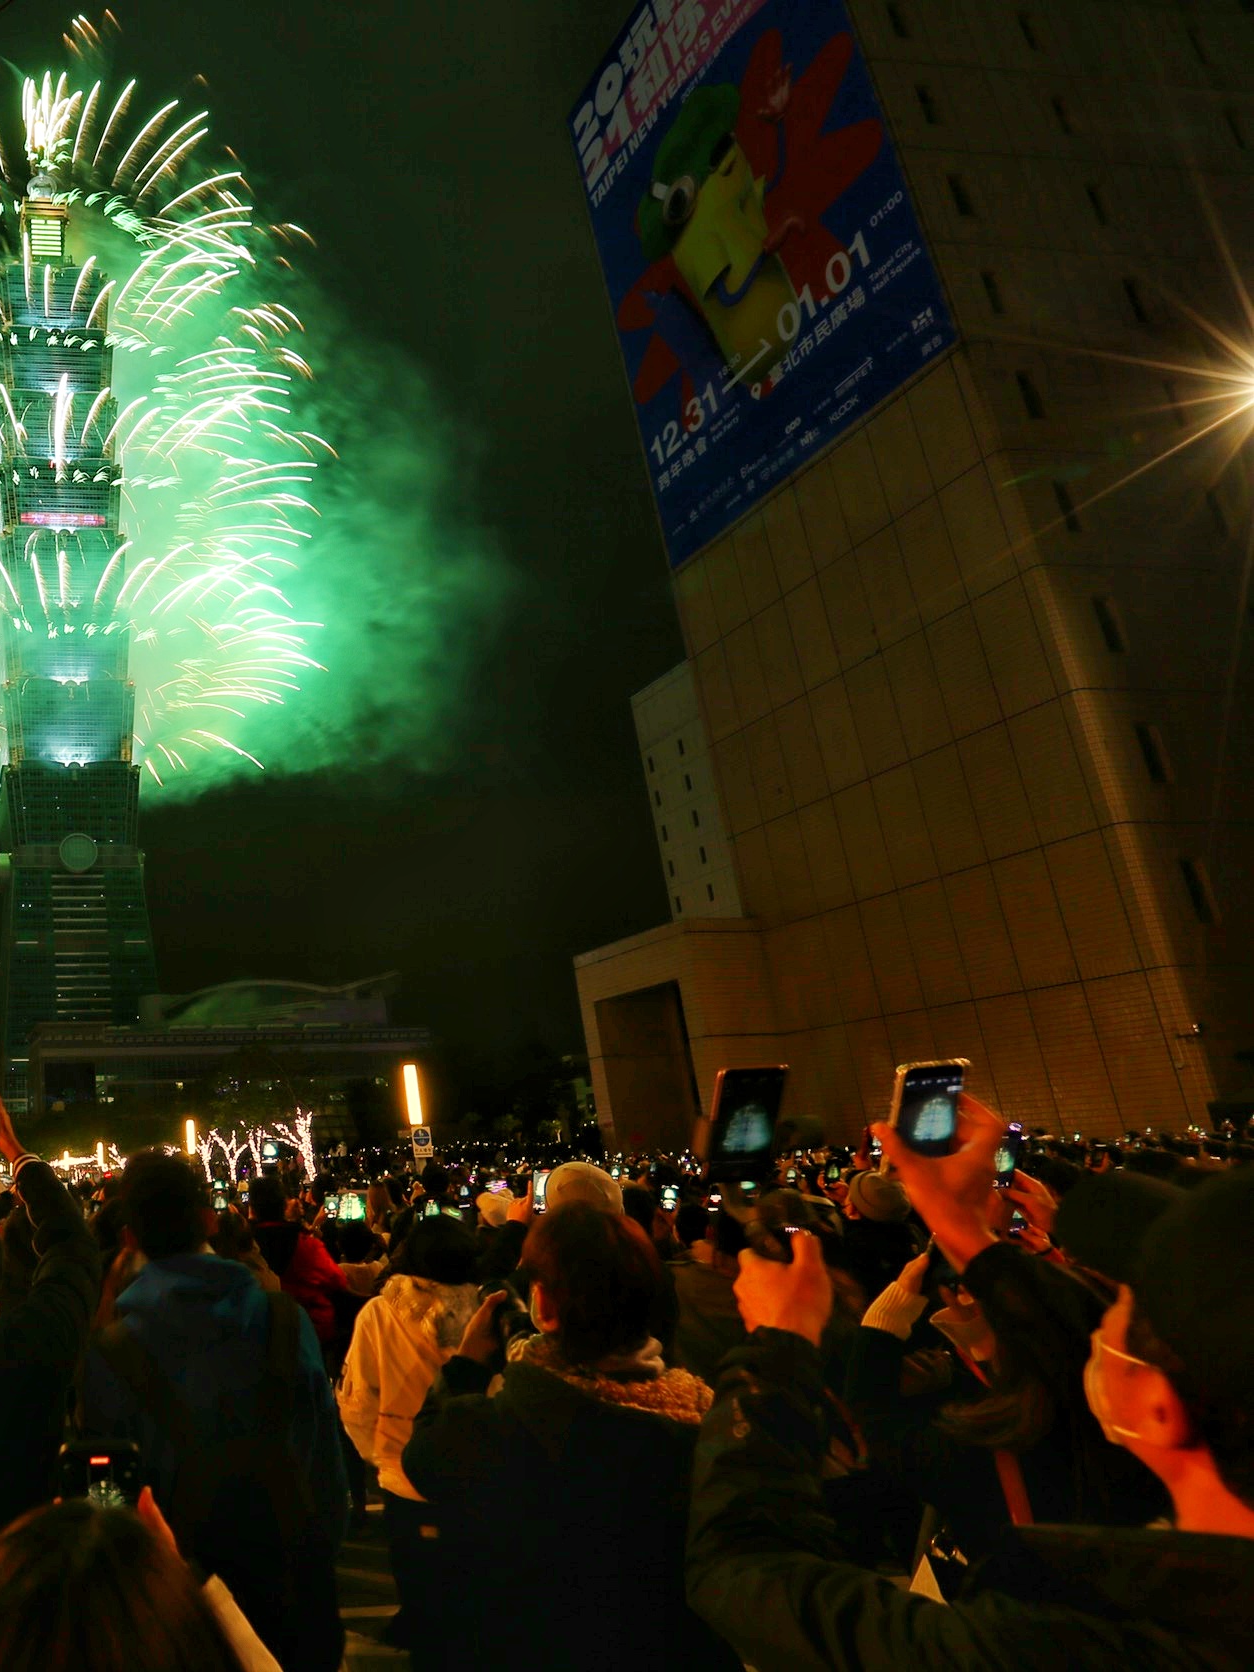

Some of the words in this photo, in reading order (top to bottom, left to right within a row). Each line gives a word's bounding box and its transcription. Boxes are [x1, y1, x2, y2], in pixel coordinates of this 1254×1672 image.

[590, 147, 629, 208] TAIPEI
[628, 104, 658, 156] NEW
[658, 29, 711, 110] YEAR'S
[869, 190, 903, 227] 01:00
[776, 230, 871, 342] 01.01
[867, 255, 895, 283] Taipei
[894, 239, 913, 259] City
[871, 274, 891, 295] Hall
[889, 247, 922, 279] Square
[768, 285, 866, 388] 臺北市民廣場
[650, 381, 718, 466] 12.31
[828, 393, 860, 425] KLOOK
[657, 436, 707, 493] 跨年晚會
